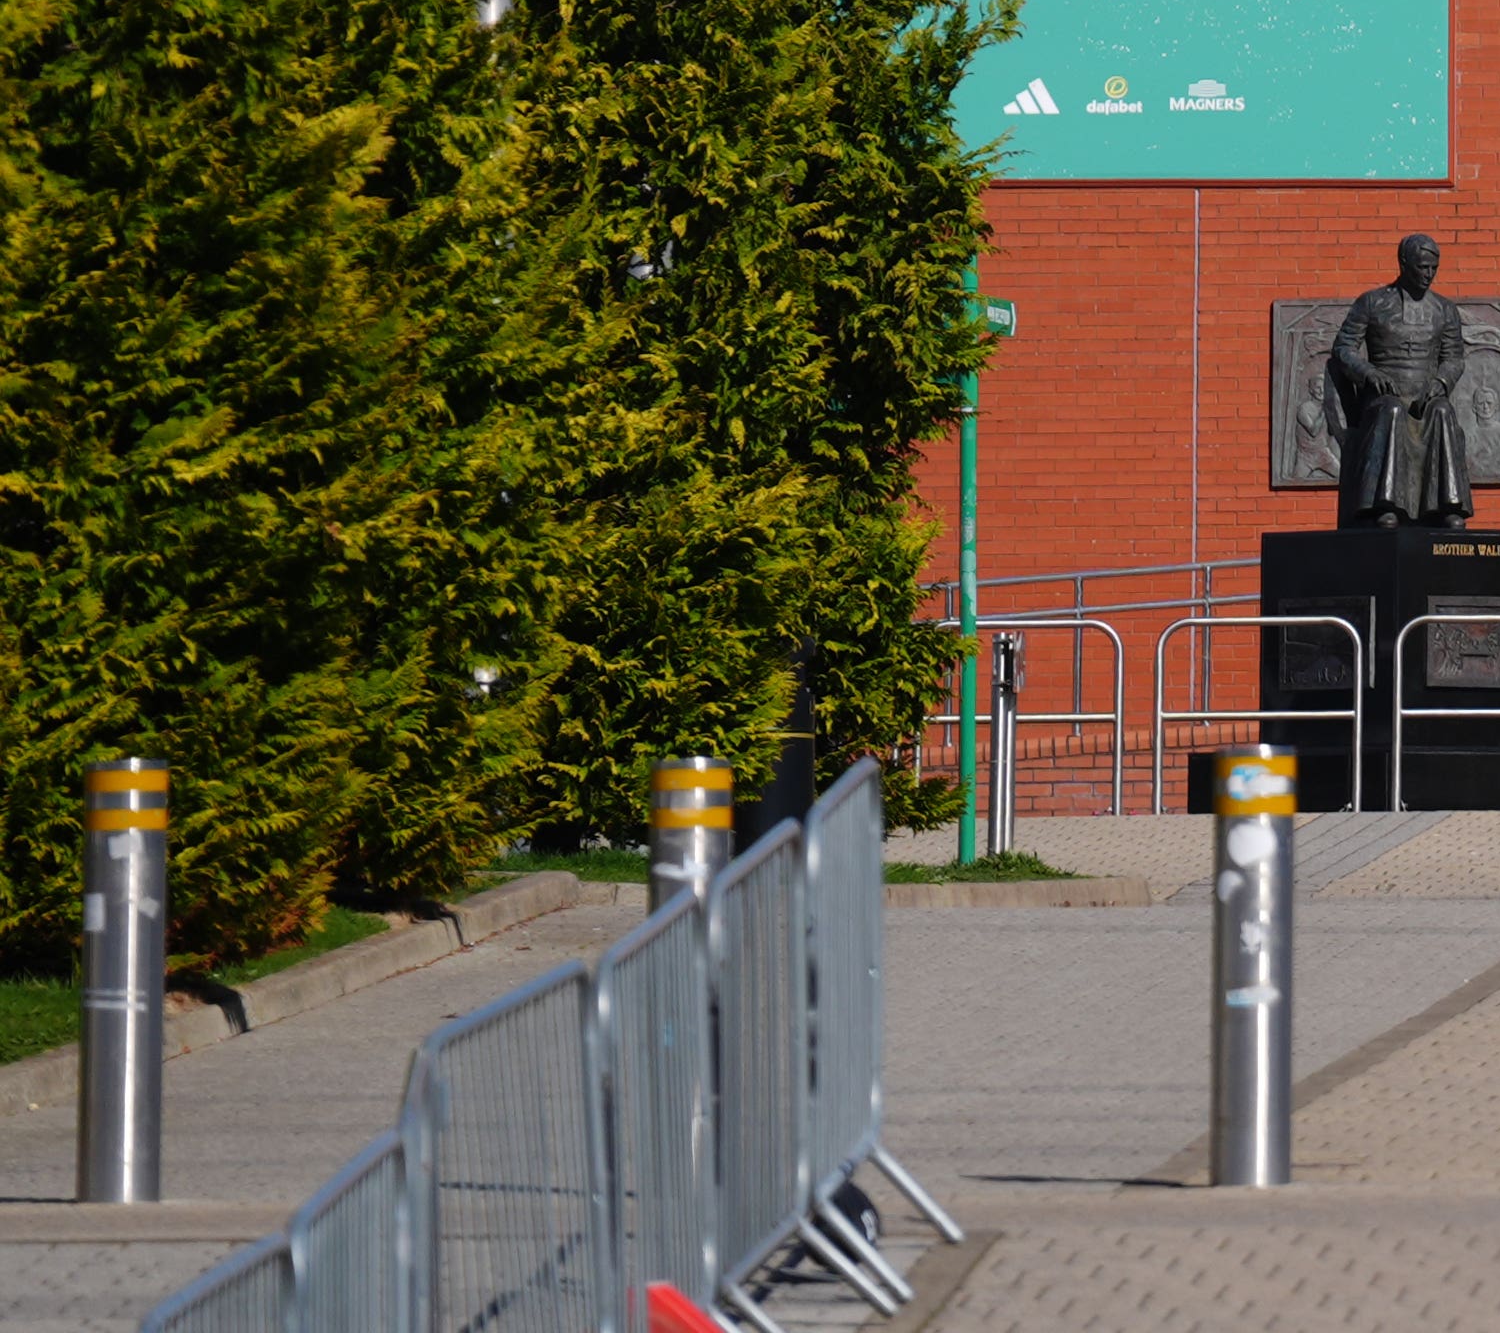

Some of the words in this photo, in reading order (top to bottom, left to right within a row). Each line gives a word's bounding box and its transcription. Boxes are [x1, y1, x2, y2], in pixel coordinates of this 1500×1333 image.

[1086, 99, 1143, 115] dafabet
[1169, 96, 1246, 112] MAGNERS
[1432, 543, 1475, 556] BROTHER
